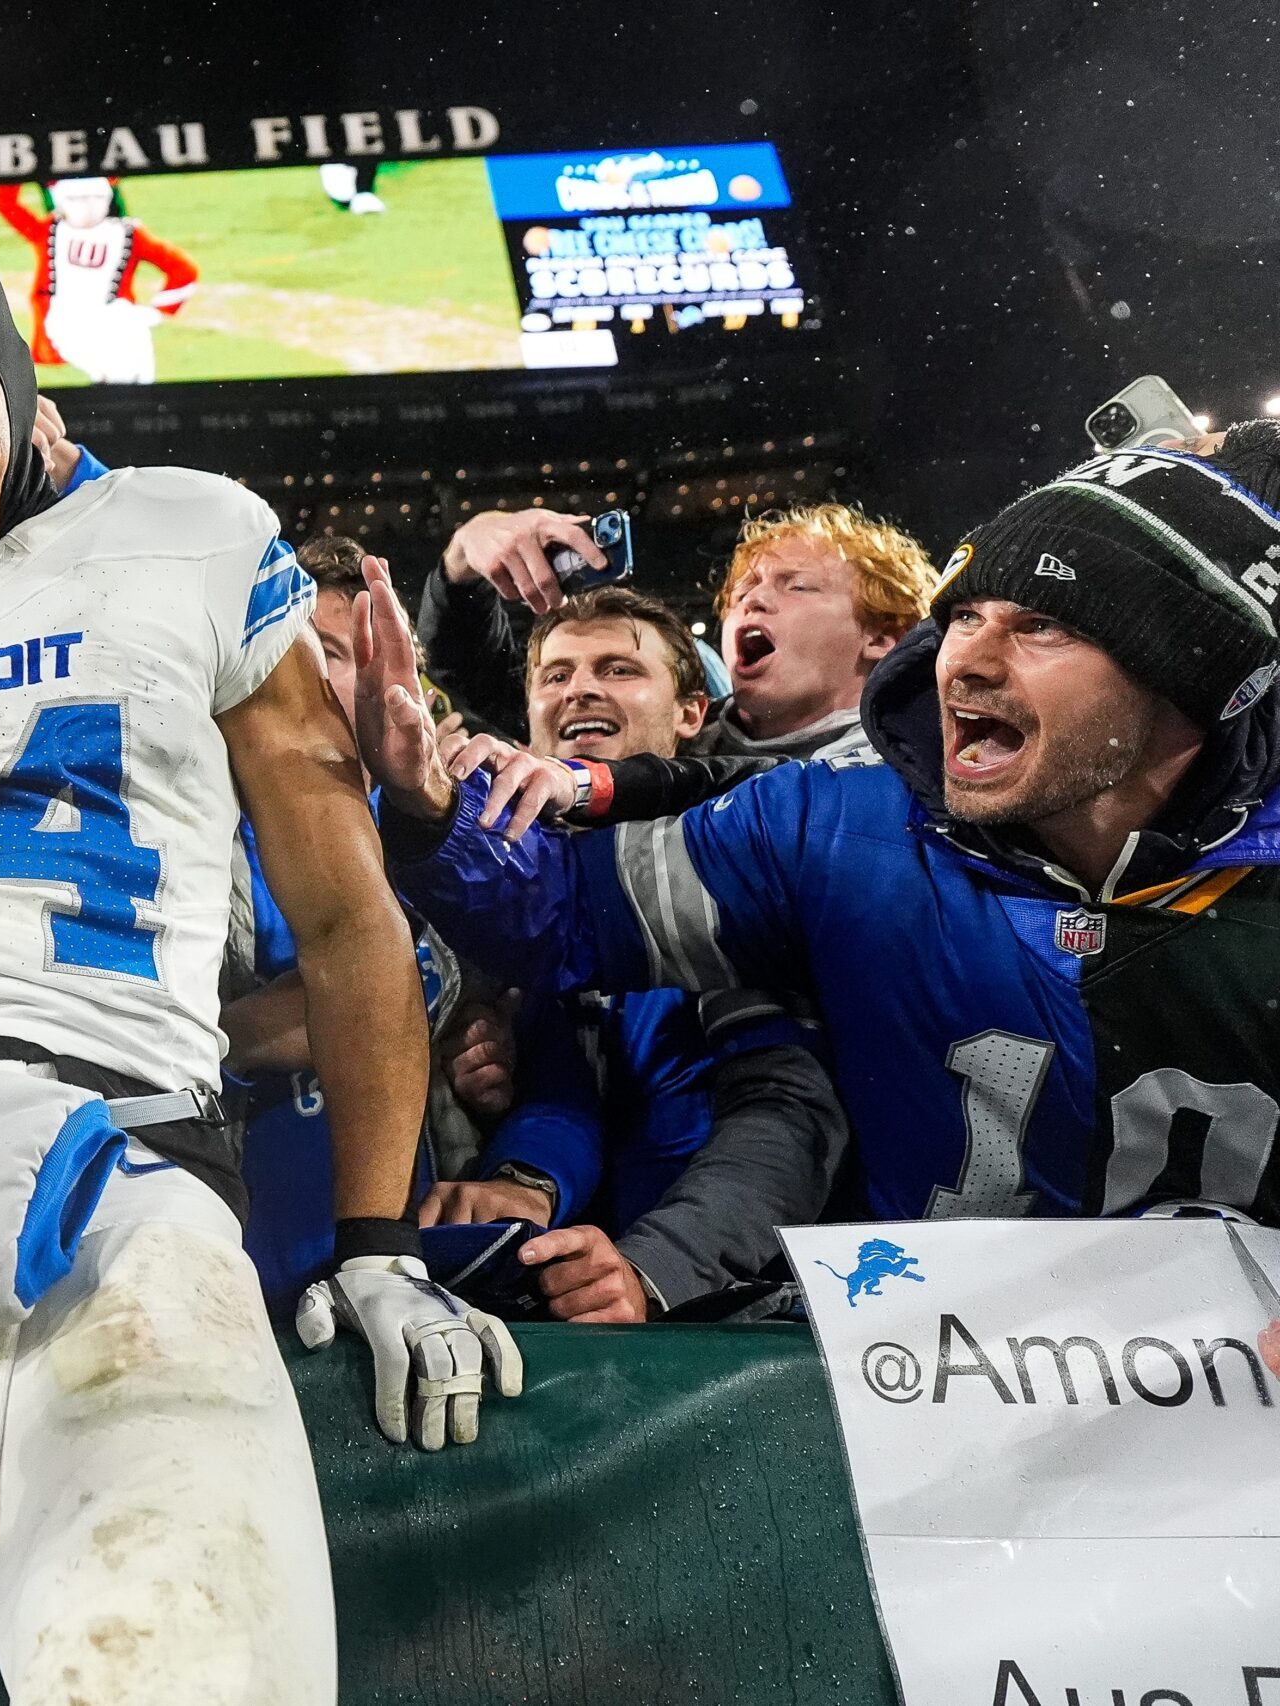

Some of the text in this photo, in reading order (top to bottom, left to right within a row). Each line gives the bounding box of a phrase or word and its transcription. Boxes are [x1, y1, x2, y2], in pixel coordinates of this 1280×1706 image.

[251, 106, 501, 161] FIELD
[1062, 930, 1098, 951] NFL
[860, 1313, 1275, 1408] @Amon
